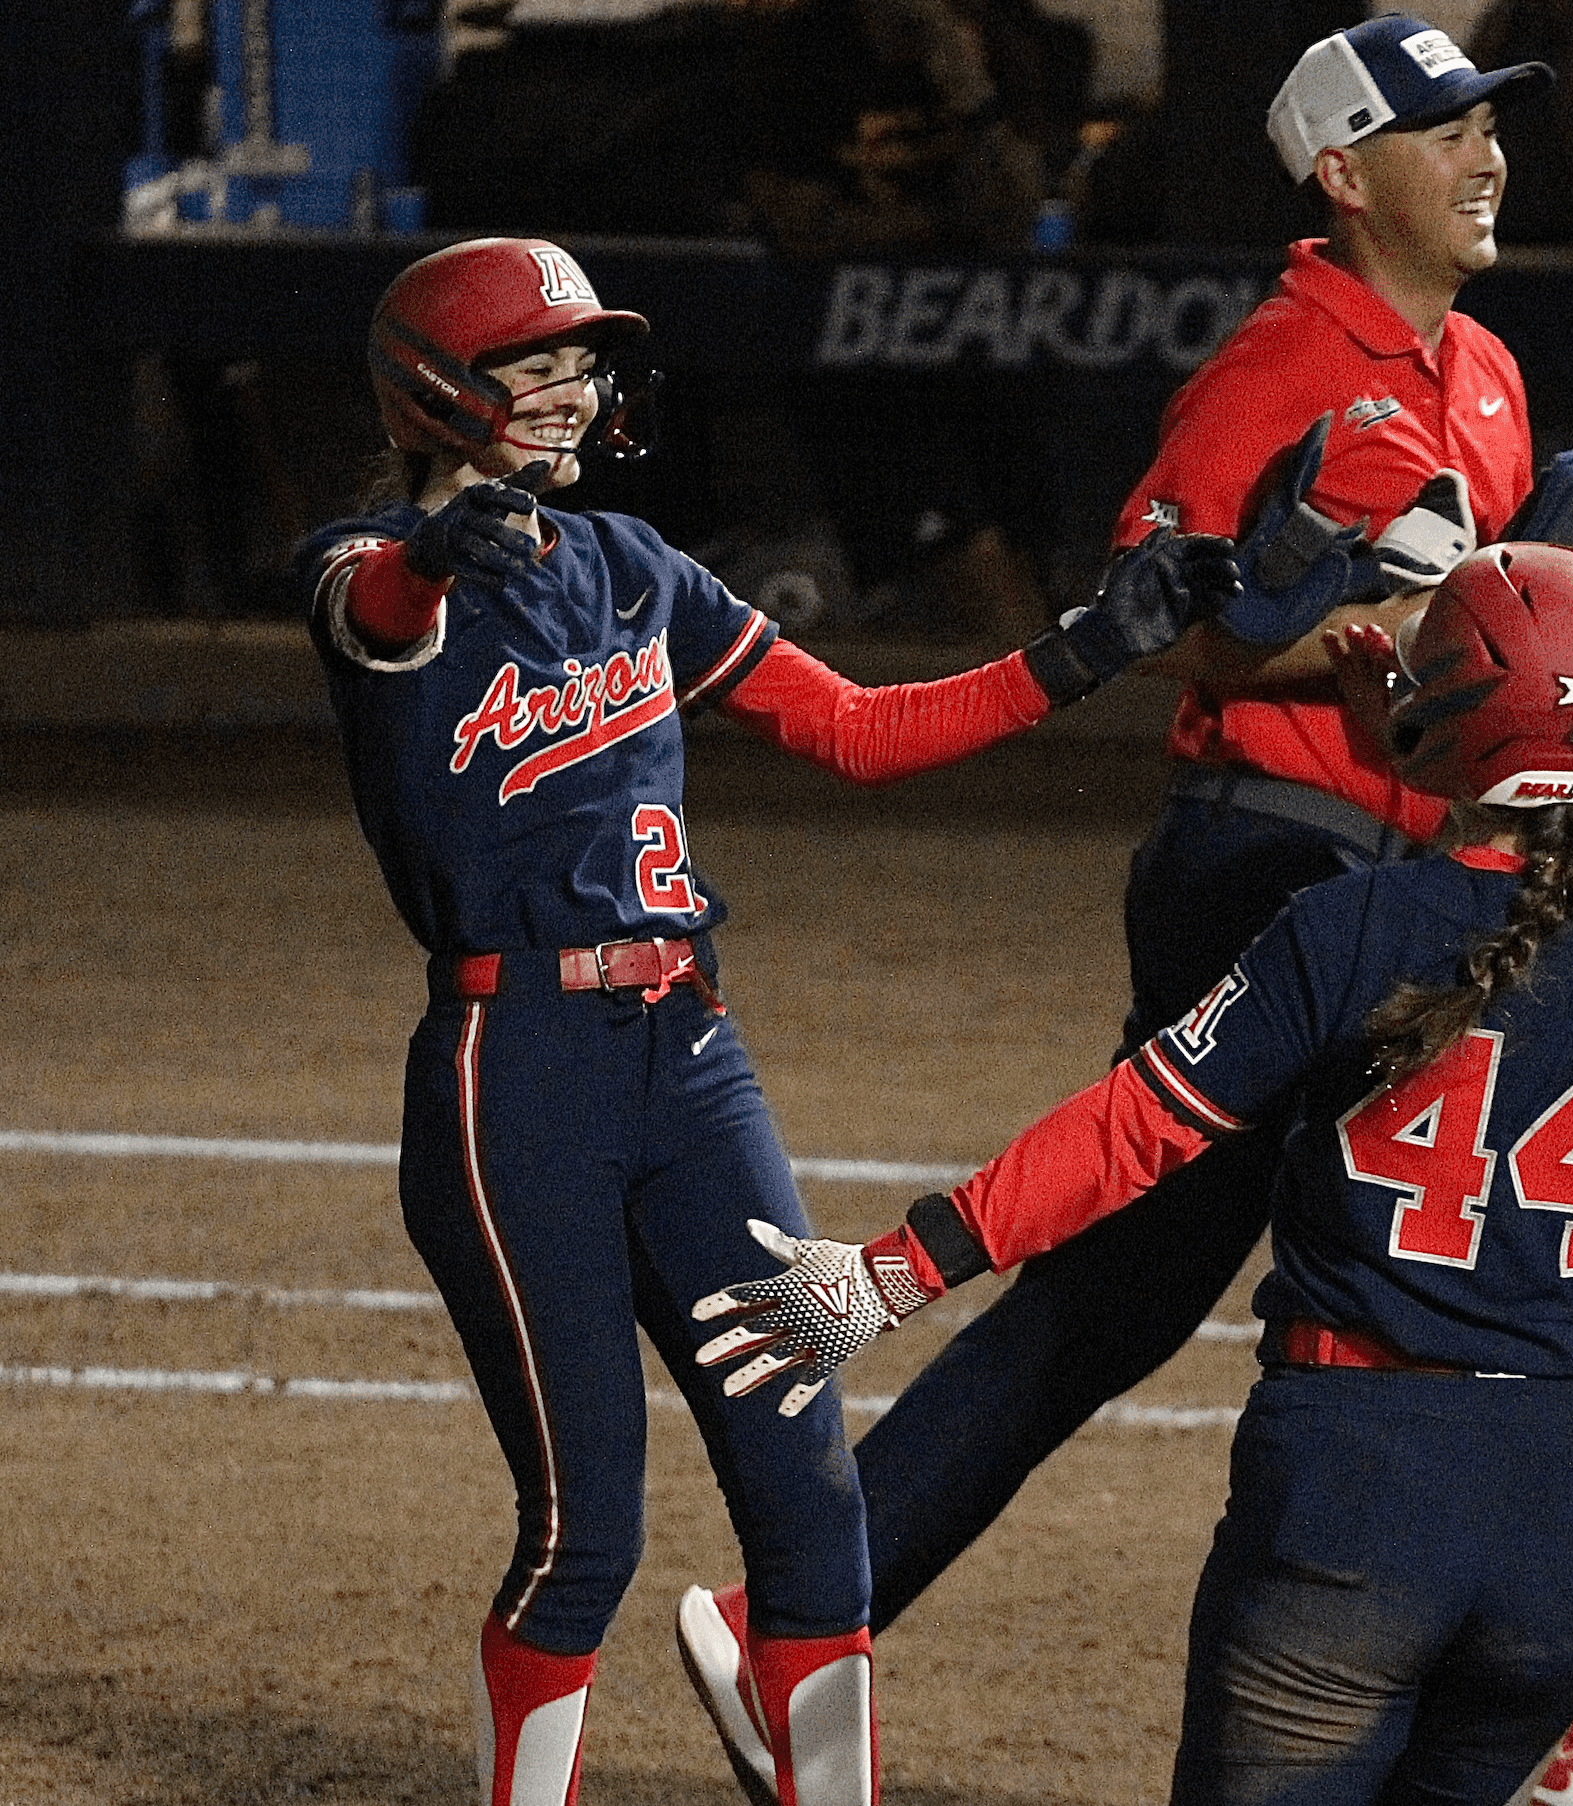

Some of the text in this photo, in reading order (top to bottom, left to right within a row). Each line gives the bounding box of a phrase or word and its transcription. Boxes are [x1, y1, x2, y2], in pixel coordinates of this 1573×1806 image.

[529, 248, 602, 307] A
[818, 267, 1262, 367] BEARDO
[417, 362, 460, 398] EASTON
[450, 627, 677, 774] Arizon
[632, 804, 708, 917] 2
